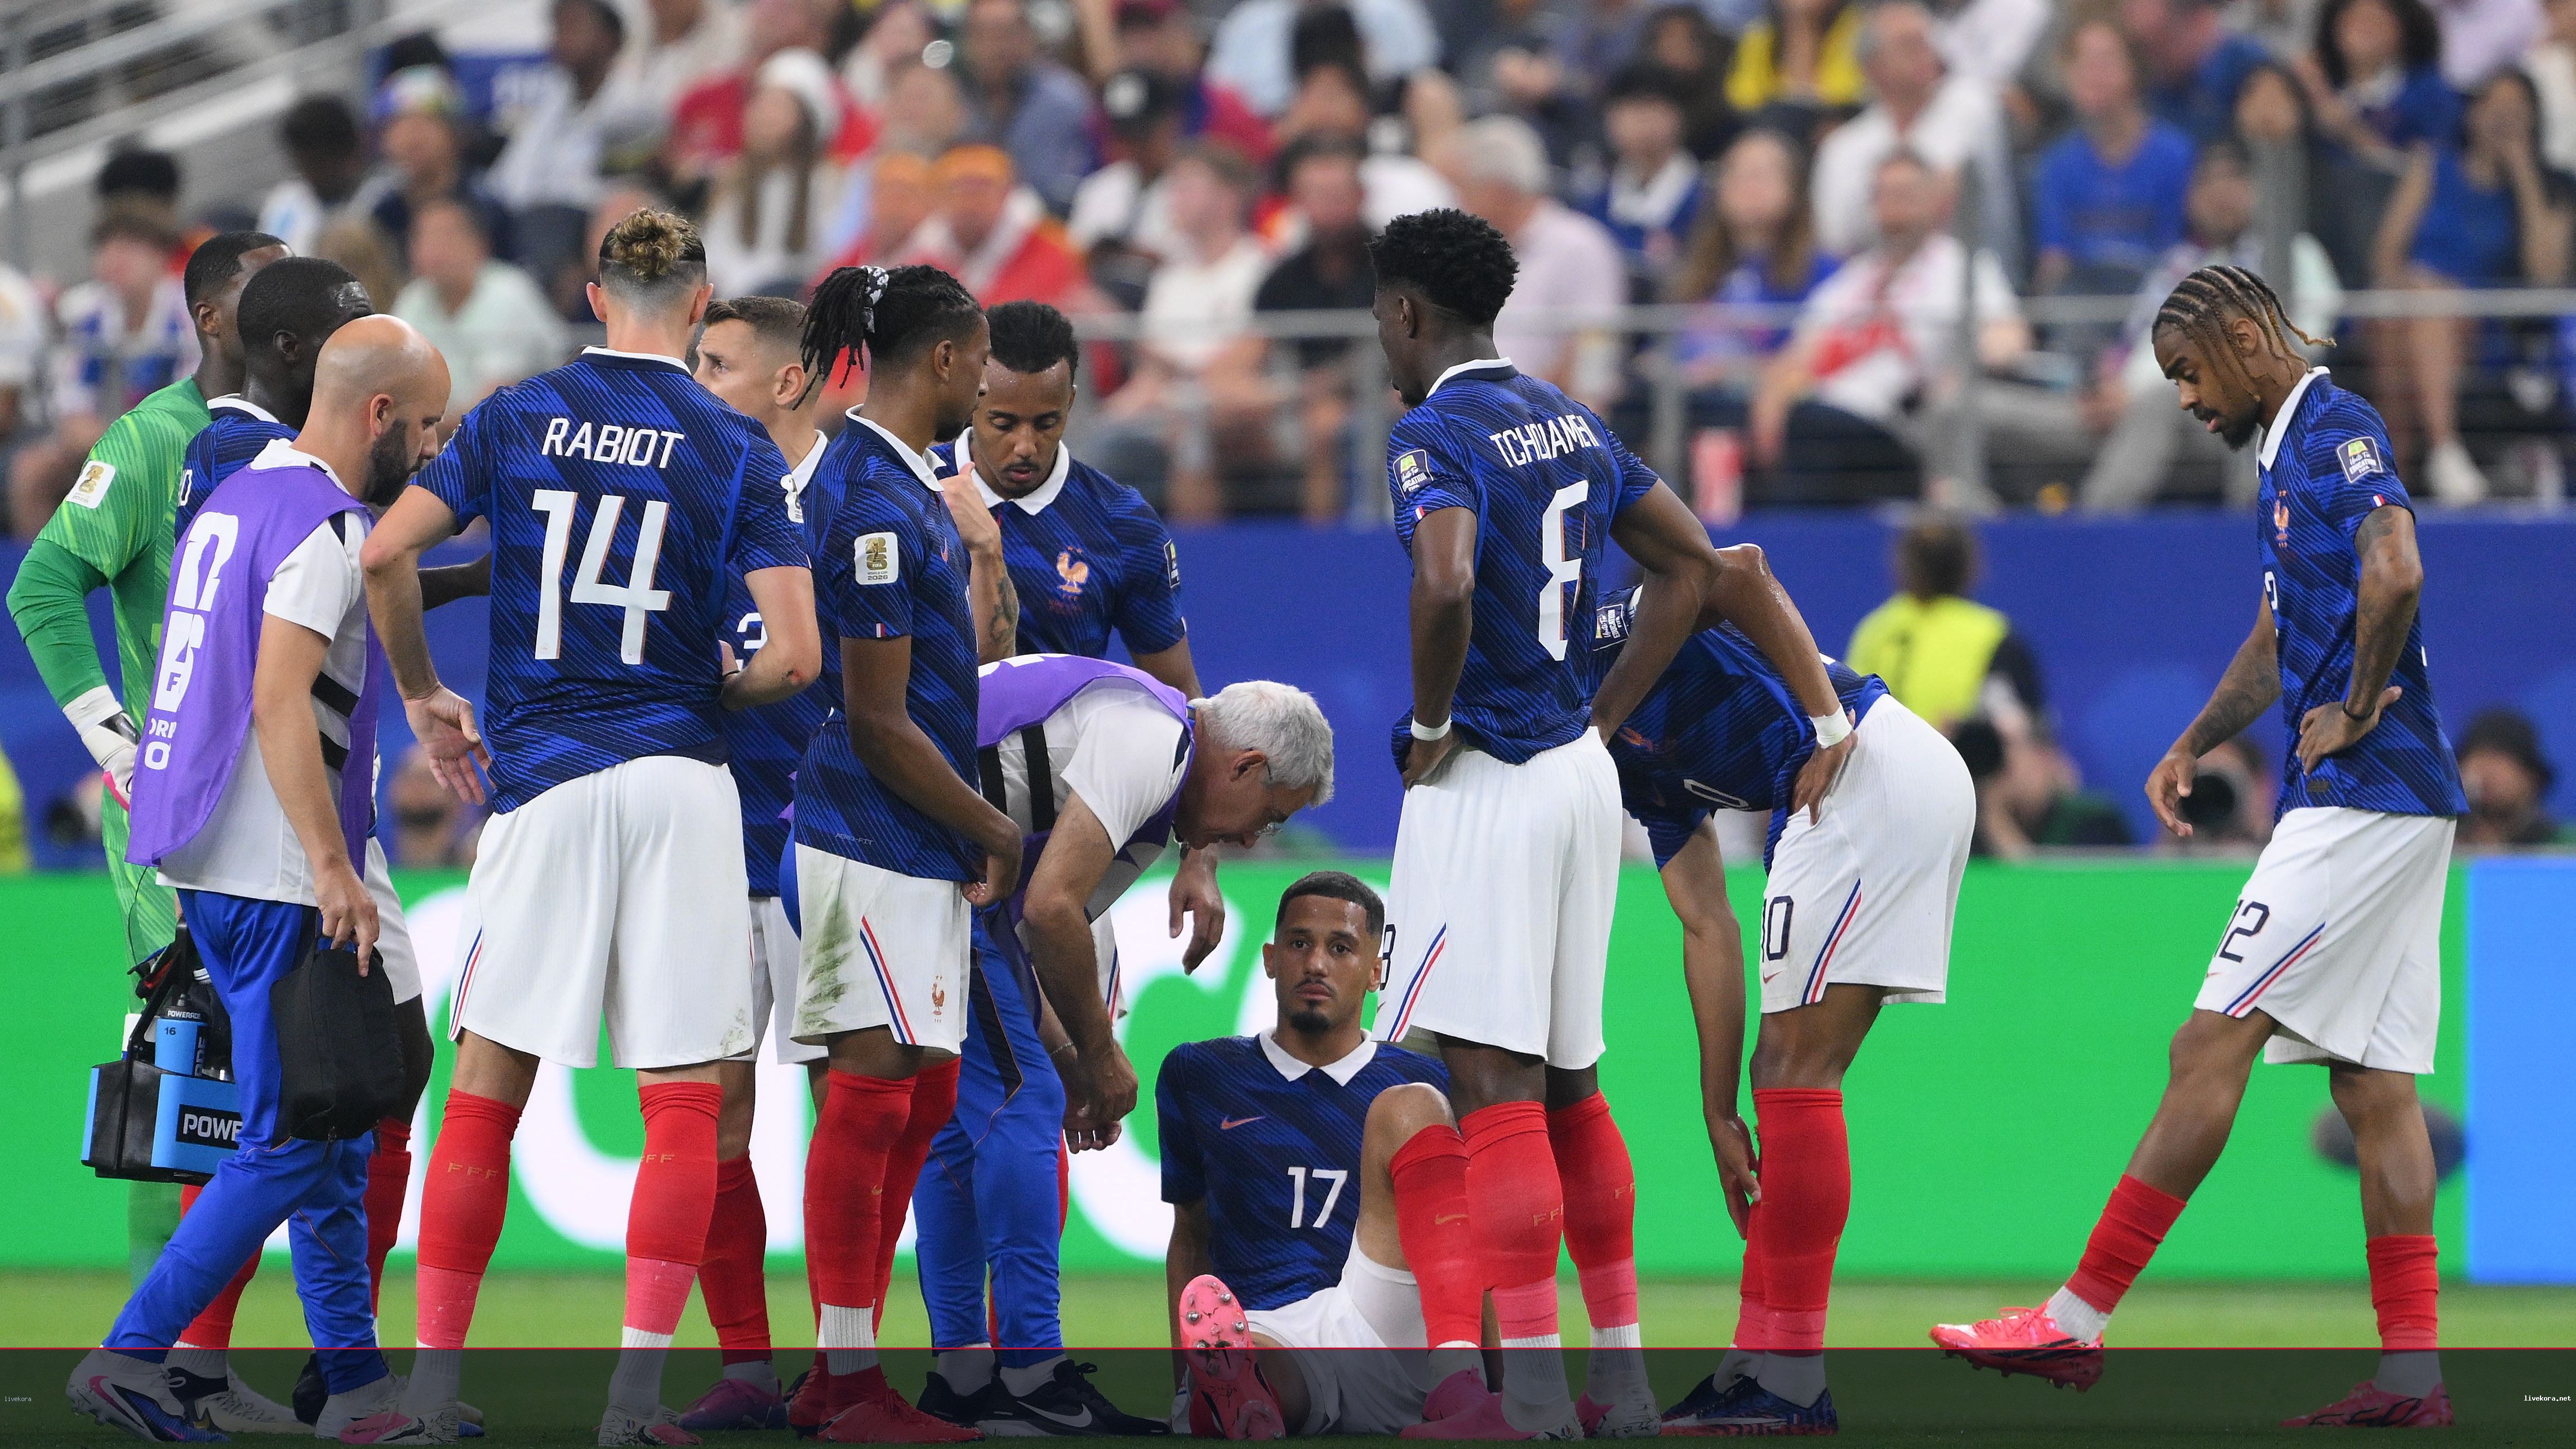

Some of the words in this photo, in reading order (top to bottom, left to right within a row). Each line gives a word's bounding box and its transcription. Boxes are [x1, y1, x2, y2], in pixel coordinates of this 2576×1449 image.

[541, 417, 684, 468] RABIOT
[531, 489, 674, 665] 14
[164, 1027, 176, 1035] 16
[1287, 1166, 1347, 1228] 17
